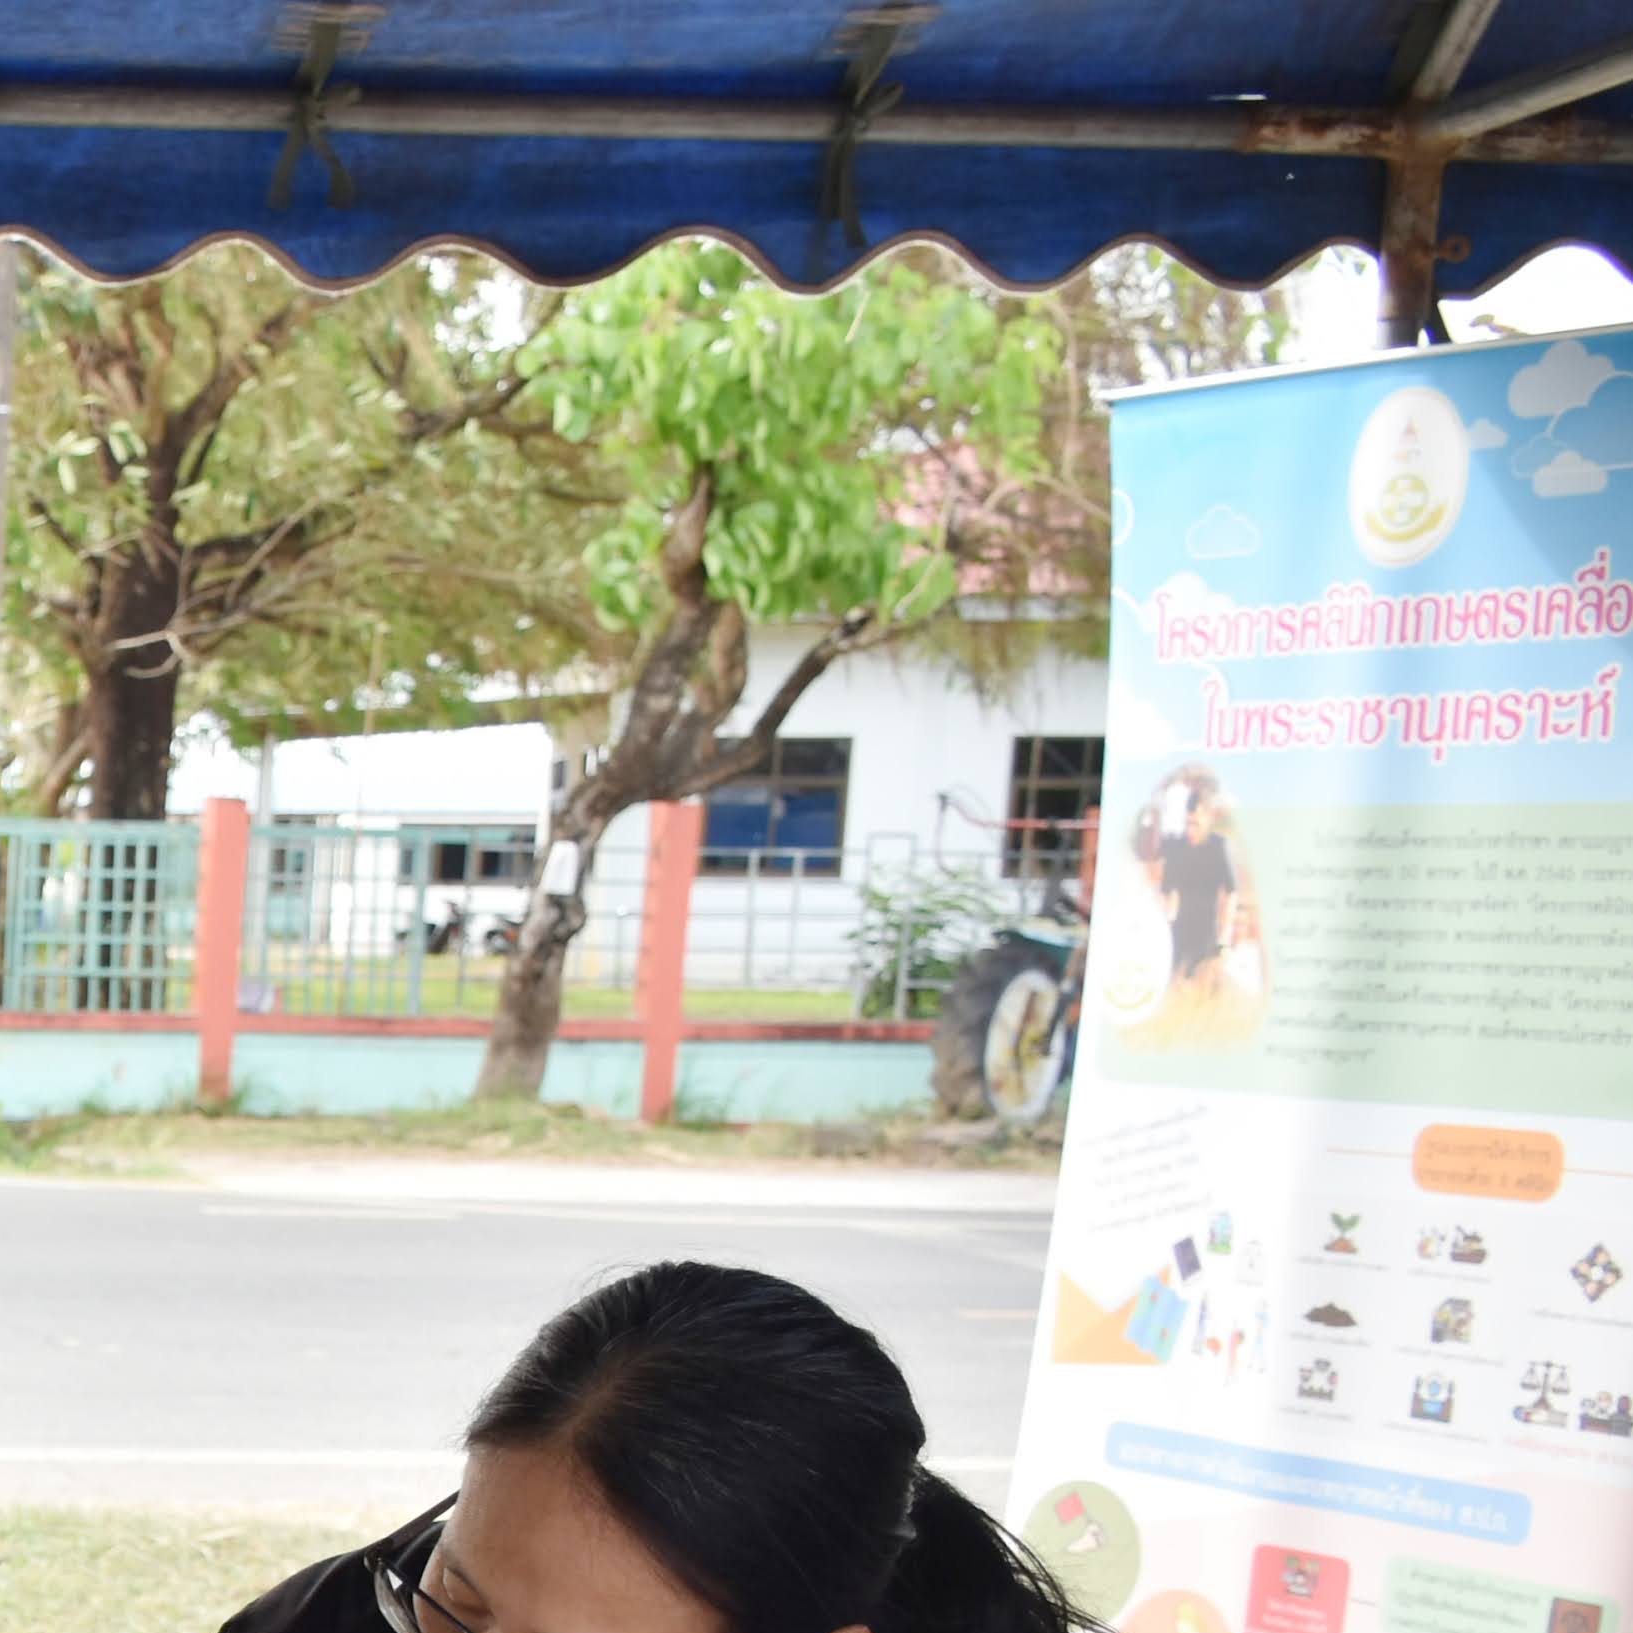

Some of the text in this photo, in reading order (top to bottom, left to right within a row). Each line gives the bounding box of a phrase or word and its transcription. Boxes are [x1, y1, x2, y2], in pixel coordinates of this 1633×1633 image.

[1202, 664, 1621, 766] ในพระราชานุเคราะห์
